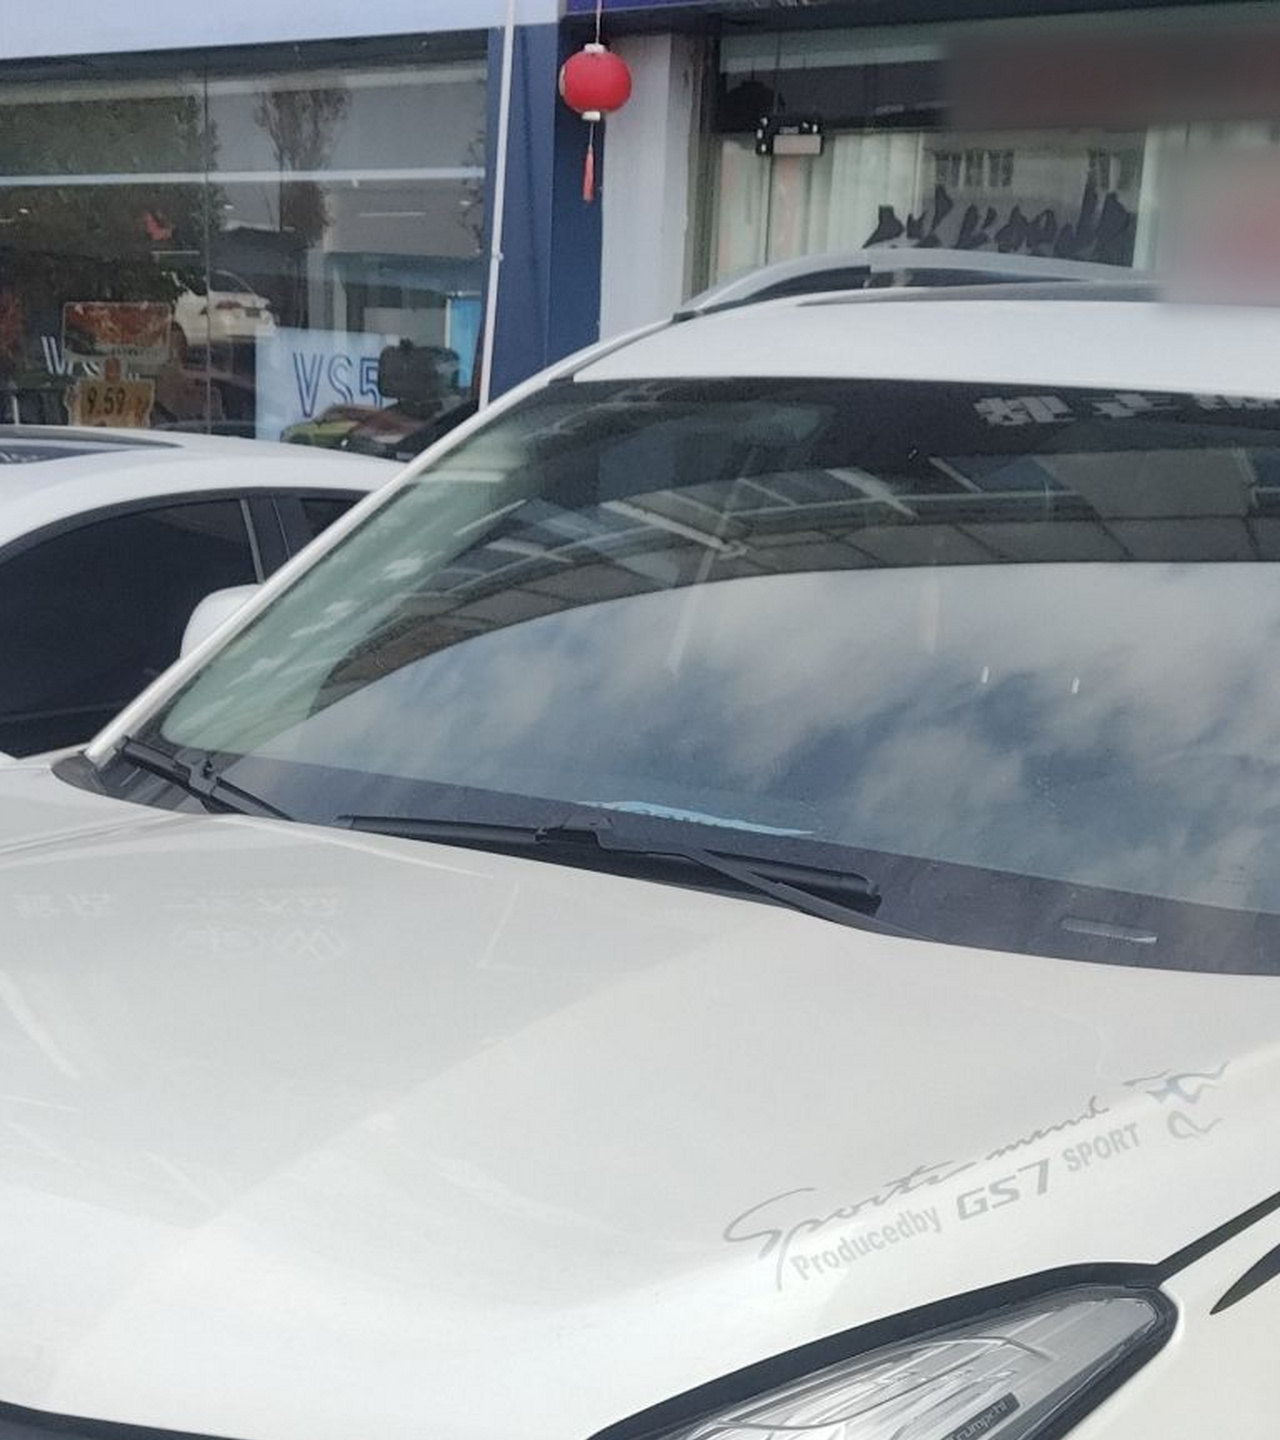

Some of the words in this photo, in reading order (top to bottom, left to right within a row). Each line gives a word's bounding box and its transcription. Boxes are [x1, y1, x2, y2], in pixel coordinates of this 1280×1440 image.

[292, 350, 382, 418] VS5
[955, 1158, 1051, 1222] GS7
[1062, 1122, 1141, 1173] SPORT
